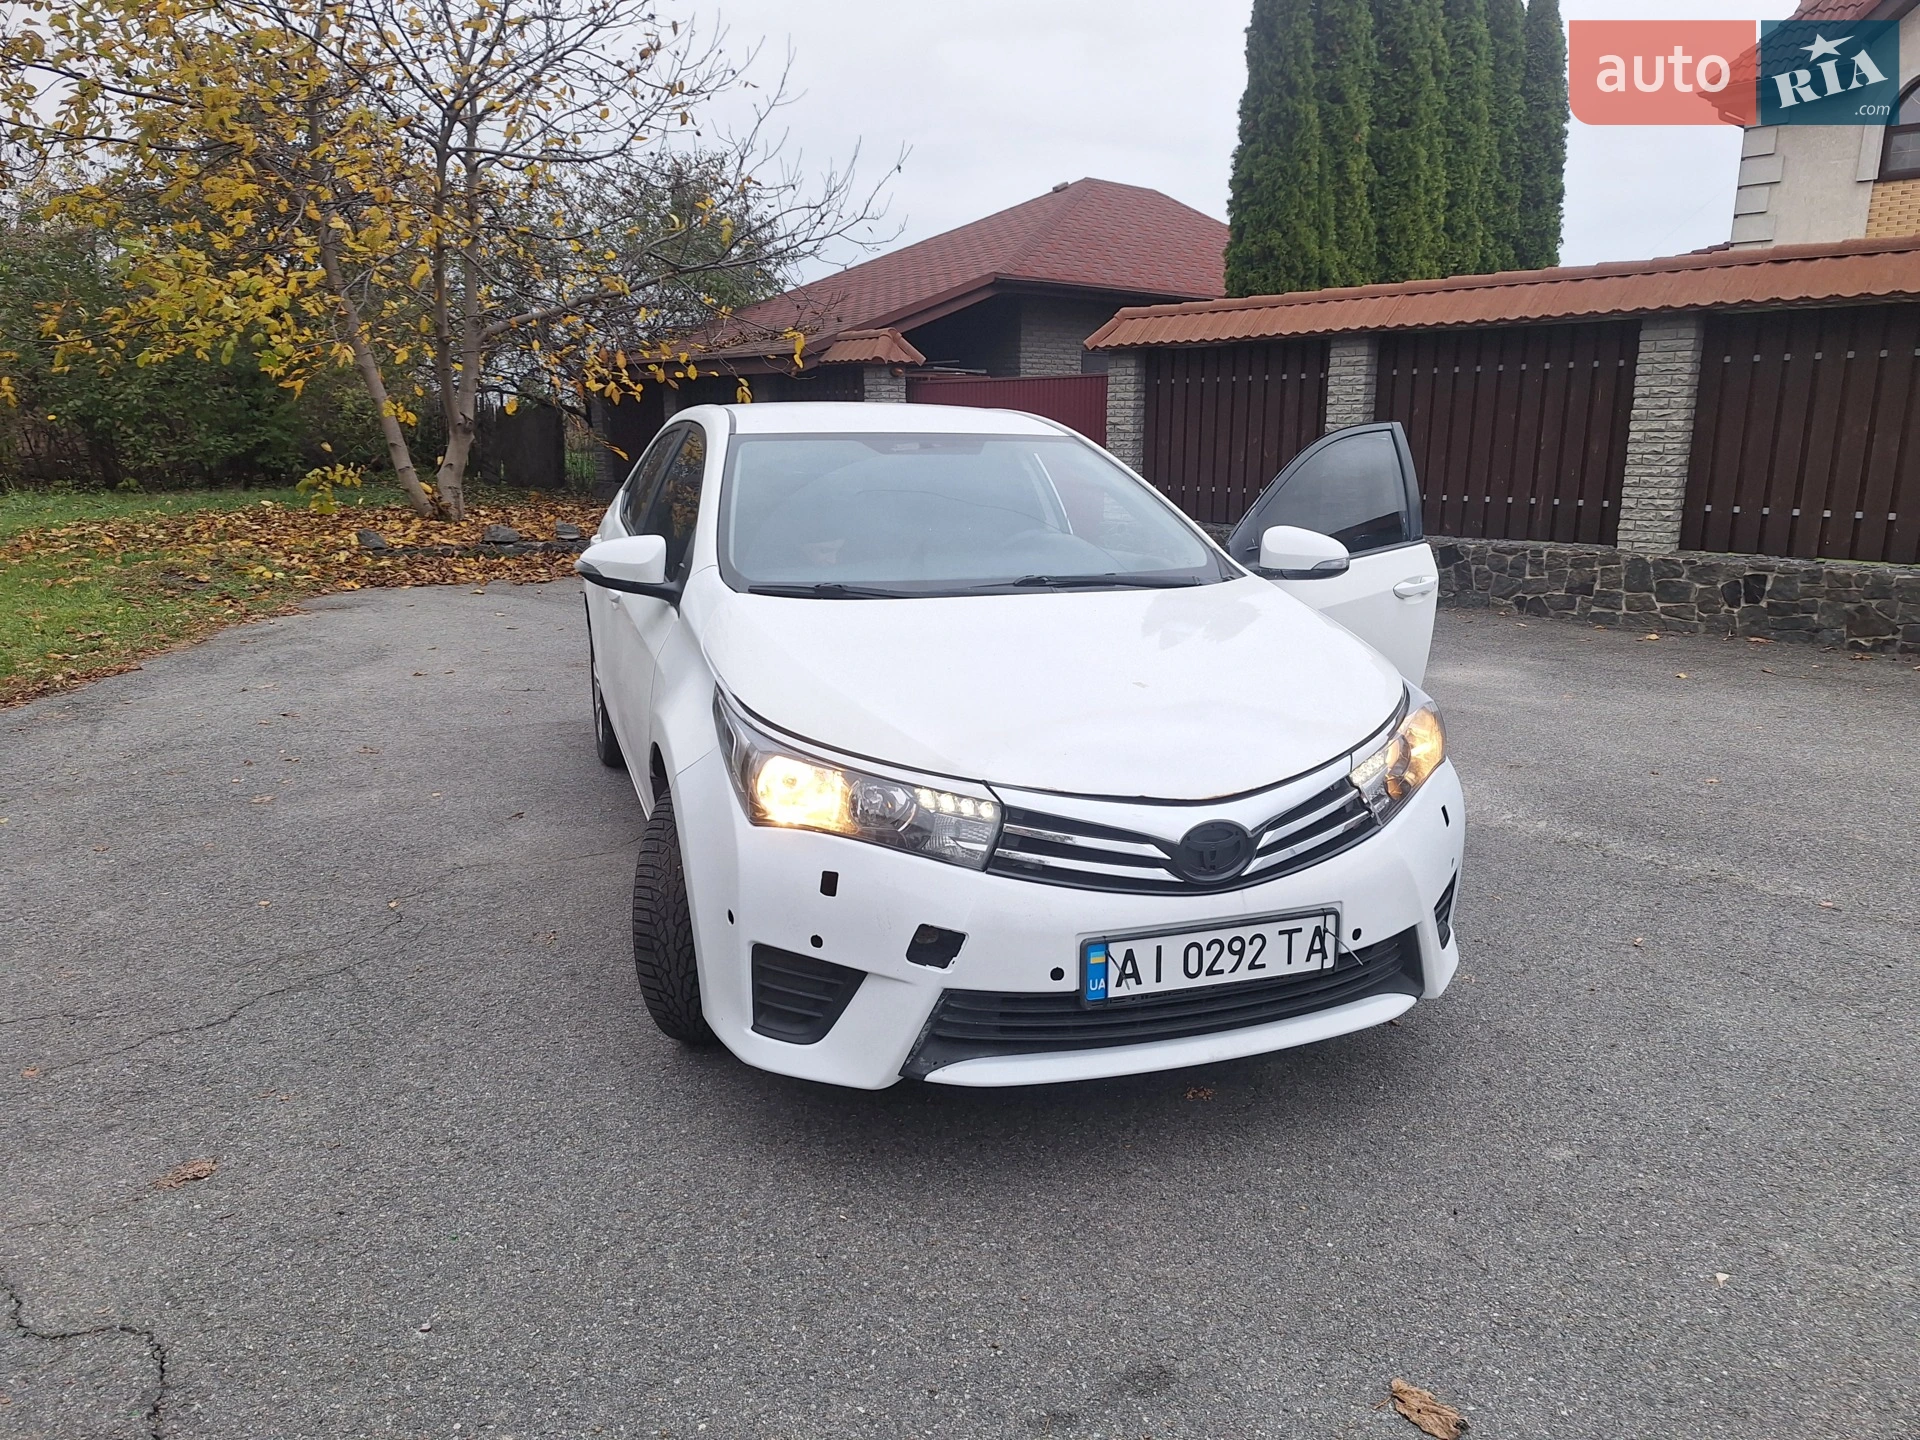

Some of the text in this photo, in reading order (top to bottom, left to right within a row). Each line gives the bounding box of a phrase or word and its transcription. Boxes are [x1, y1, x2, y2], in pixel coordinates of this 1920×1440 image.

[1115, 925, 1328, 988] AI 0292 TA
[1089, 978, 1106, 991] UA
